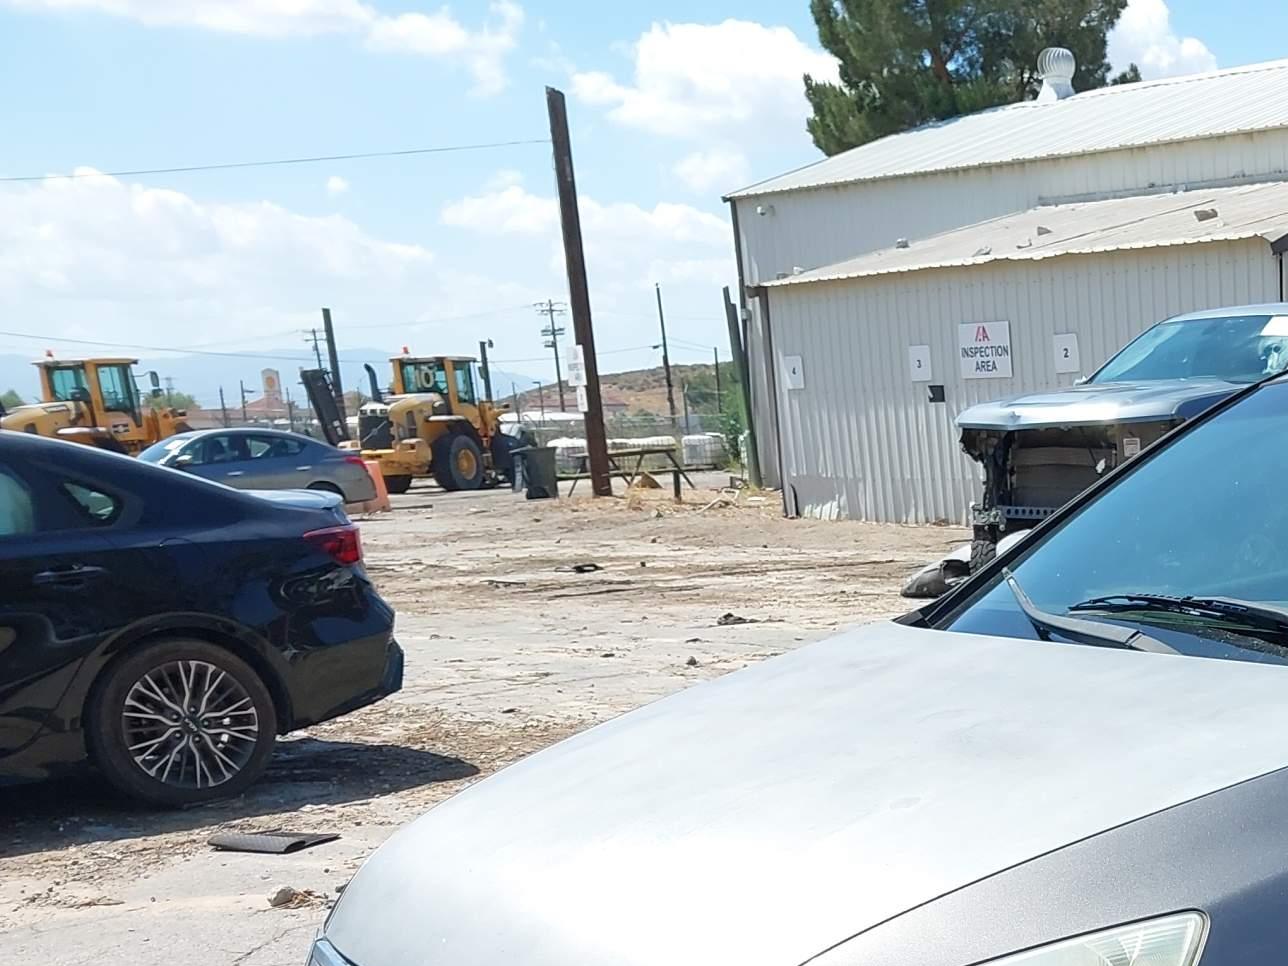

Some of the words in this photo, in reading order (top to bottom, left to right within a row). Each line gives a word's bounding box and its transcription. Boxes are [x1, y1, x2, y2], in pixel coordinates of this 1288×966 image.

[961, 344, 1009, 359] INSPECTION
[1063, 347, 1069, 358] 2
[916, 359, 922, 368] 3
[975, 360, 998, 372] AREA
